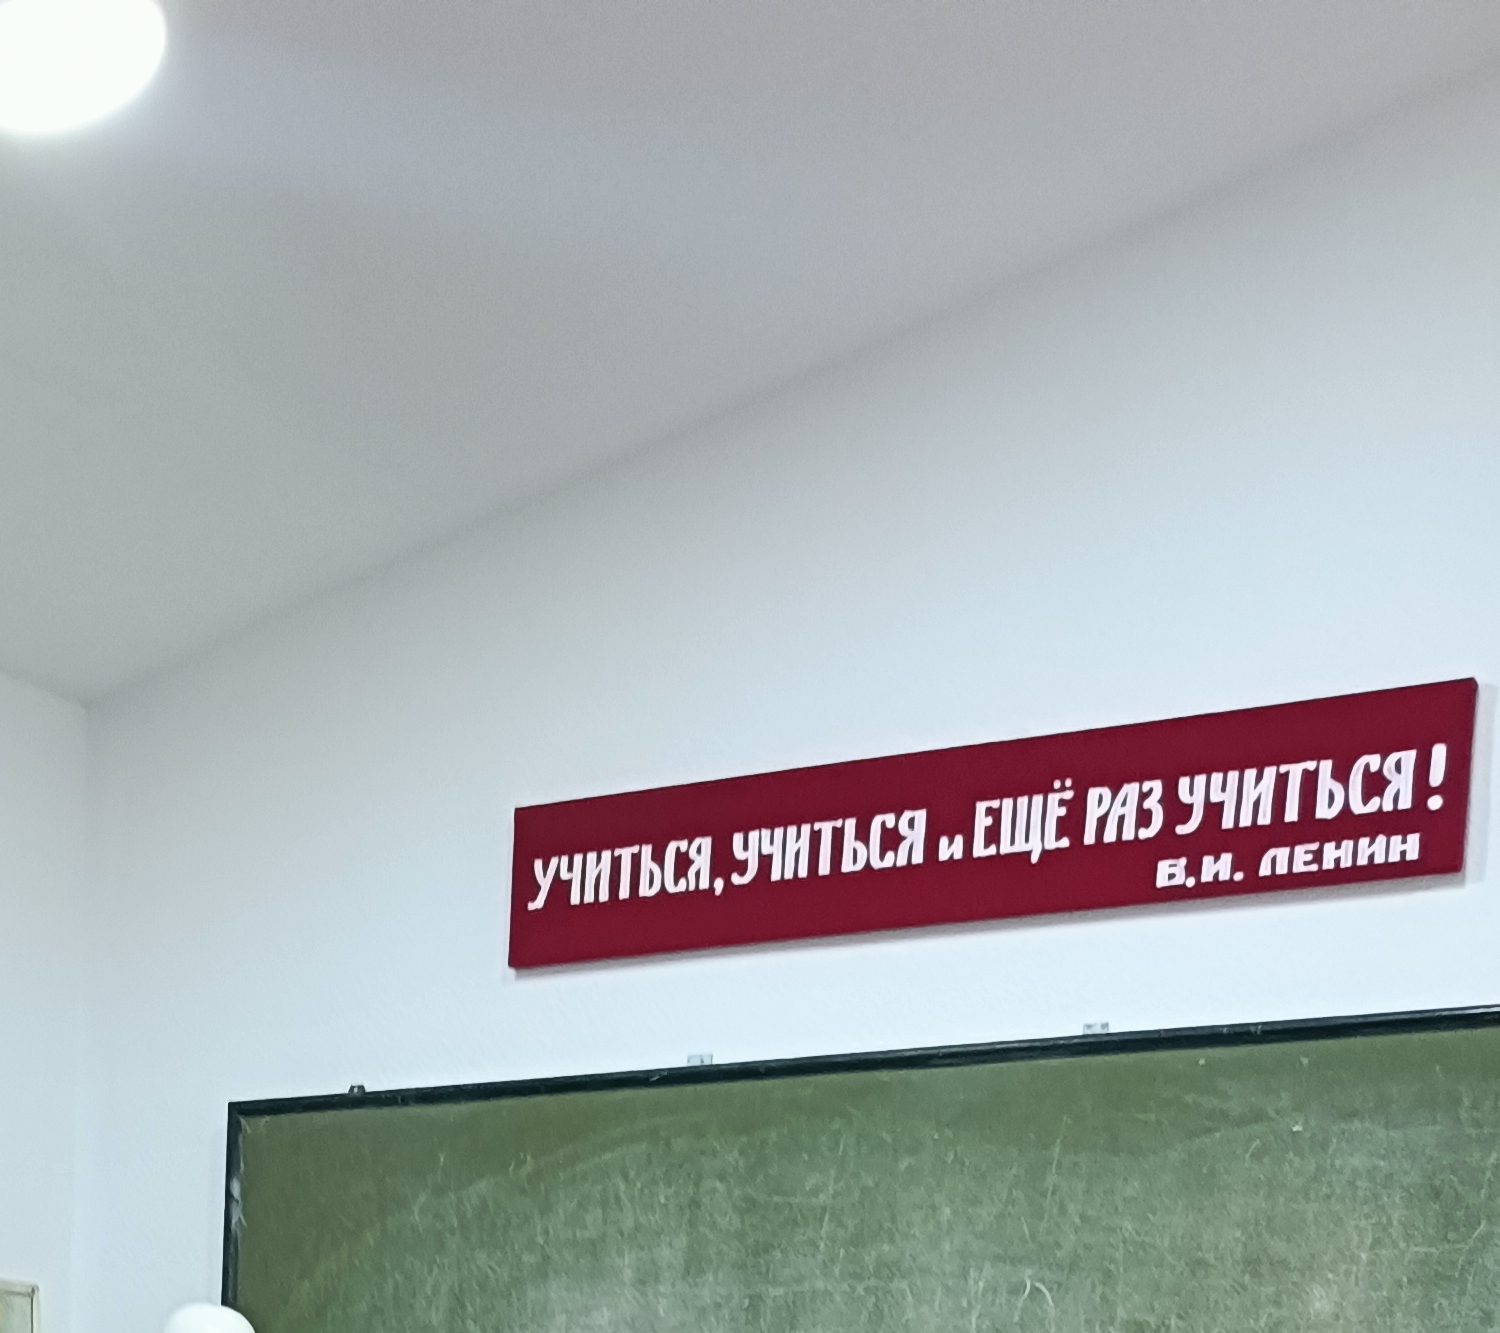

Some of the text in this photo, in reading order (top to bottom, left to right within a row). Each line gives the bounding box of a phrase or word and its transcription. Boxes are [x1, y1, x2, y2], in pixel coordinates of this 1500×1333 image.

[528, 837, 725, 911] УЧИТЬСЯ,
[731, 809, 927, 886] УЧИТЬСЯ
[973, 778, 1075, 865] ЕЩЁ
[1084, 780, 1164, 846] РАЗ
[1258, 832, 1421, 877] ЛЕНИН
